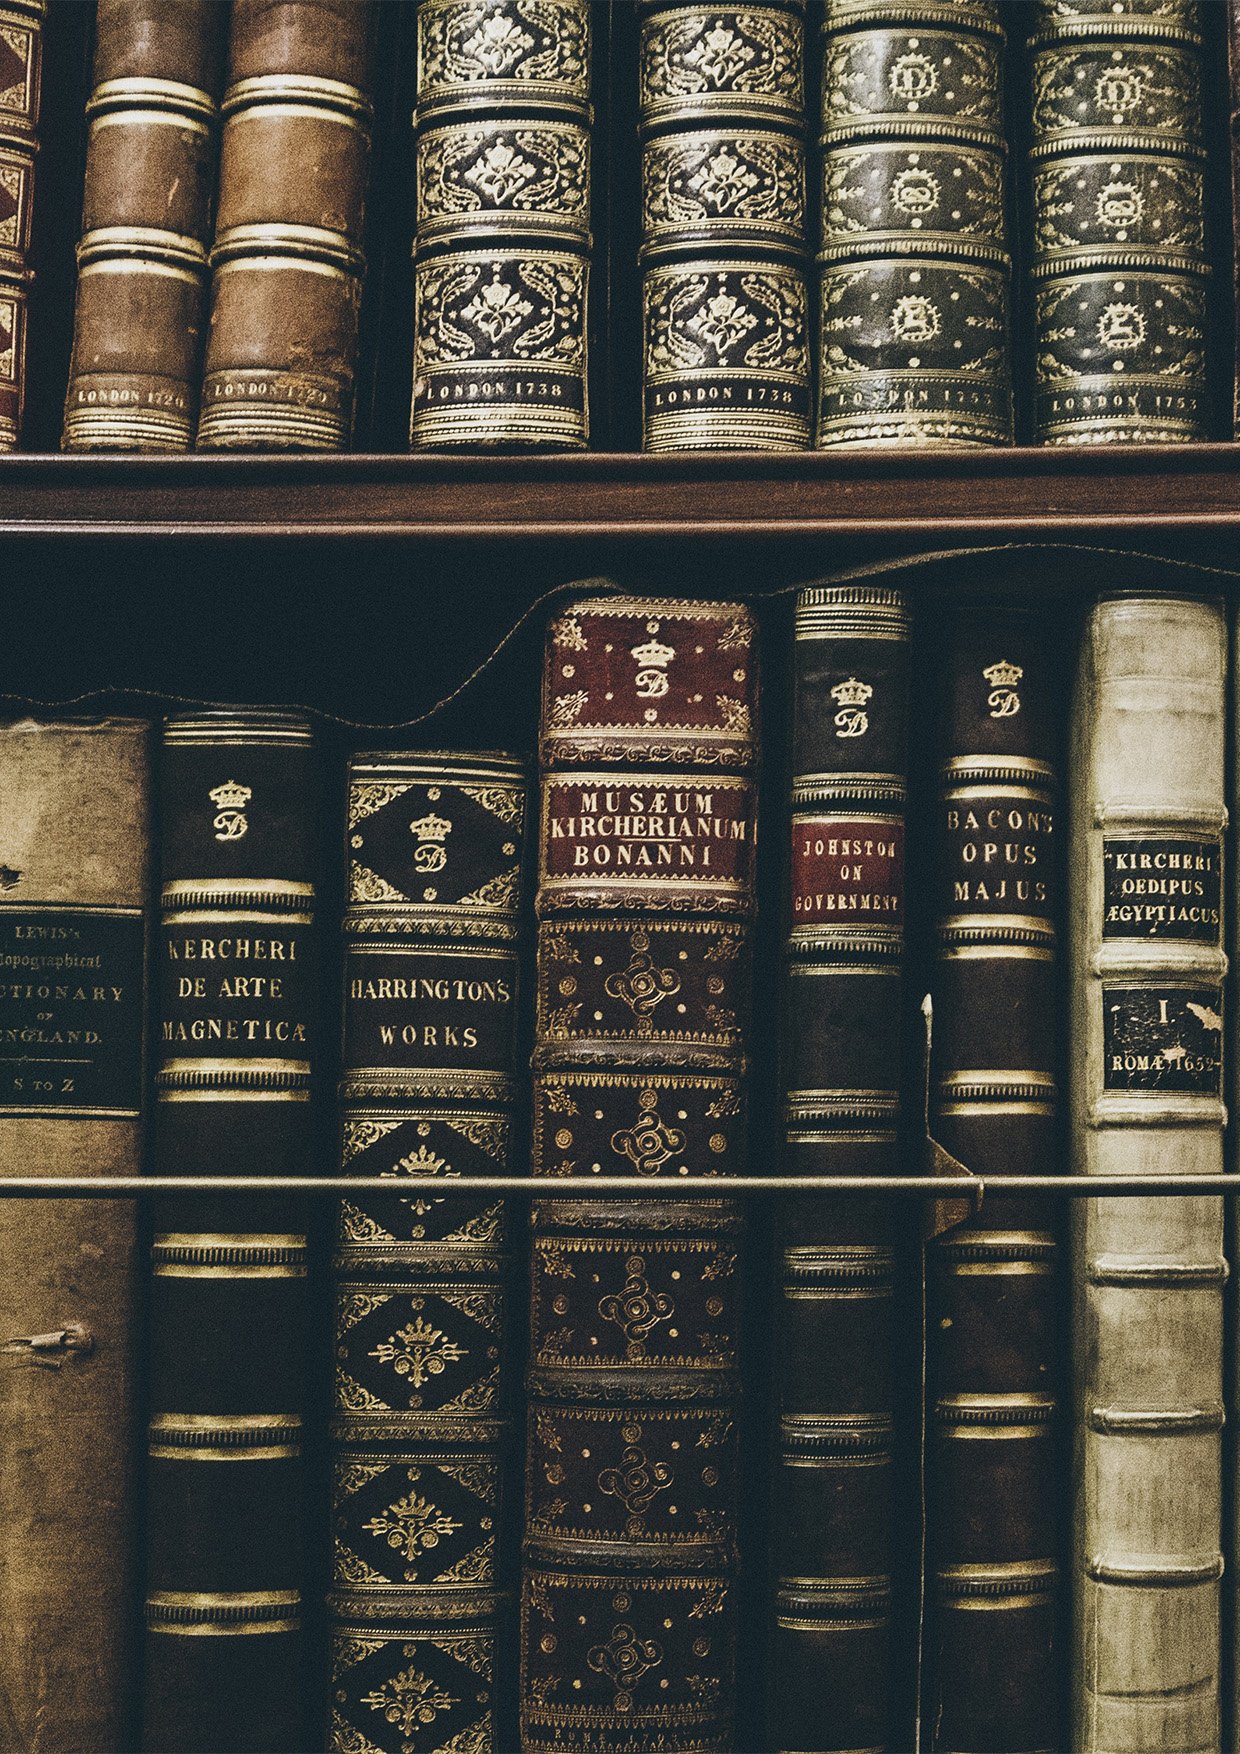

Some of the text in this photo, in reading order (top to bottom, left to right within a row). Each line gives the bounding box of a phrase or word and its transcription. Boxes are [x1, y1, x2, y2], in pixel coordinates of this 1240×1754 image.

[78, 390, 139, 402] LONDON
[215, 382, 277, 397] LONDON
[427, 382, 562, 399] LONDON 1738
[655, 387, 793, 405] LONDON 1738
[839, 390, 991, 406] LONDON 1753
[1053, 395, 1197, 412] LONDON 1753
[580, 792, 713, 815] MUSÆUM
[551, 817, 746, 840] KIRCHERIANUM
[573, 844, 711, 866] BONANNI
[803, 839, 896, 859] JOHNSTON
[962, 843, 1037, 865] OPUS
[1115, 852, 1212, 871] KIRCHERI
[840, 865, 863, 881] ON
[954, 881, 1046, 901] MAJUS
[1123, 879, 1204, 896] OEDIPUS
[795, 893, 898, 912] GOVERNMENT
[1105, 904, 1219, 924] ÆGYPTIACUS
[169, 938, 296, 961] KERCHERI
[179, 977, 282, 998] DE ARTE
[351, 978, 510, 1002] HARRINGTON'S
[1159, 1000, 1169, 1024] I
[380, 1024, 478, 1048] WORKS
[1112, 1055, 1165, 1072] ROMÆ
[61, 1078, 75, 1092] Z
